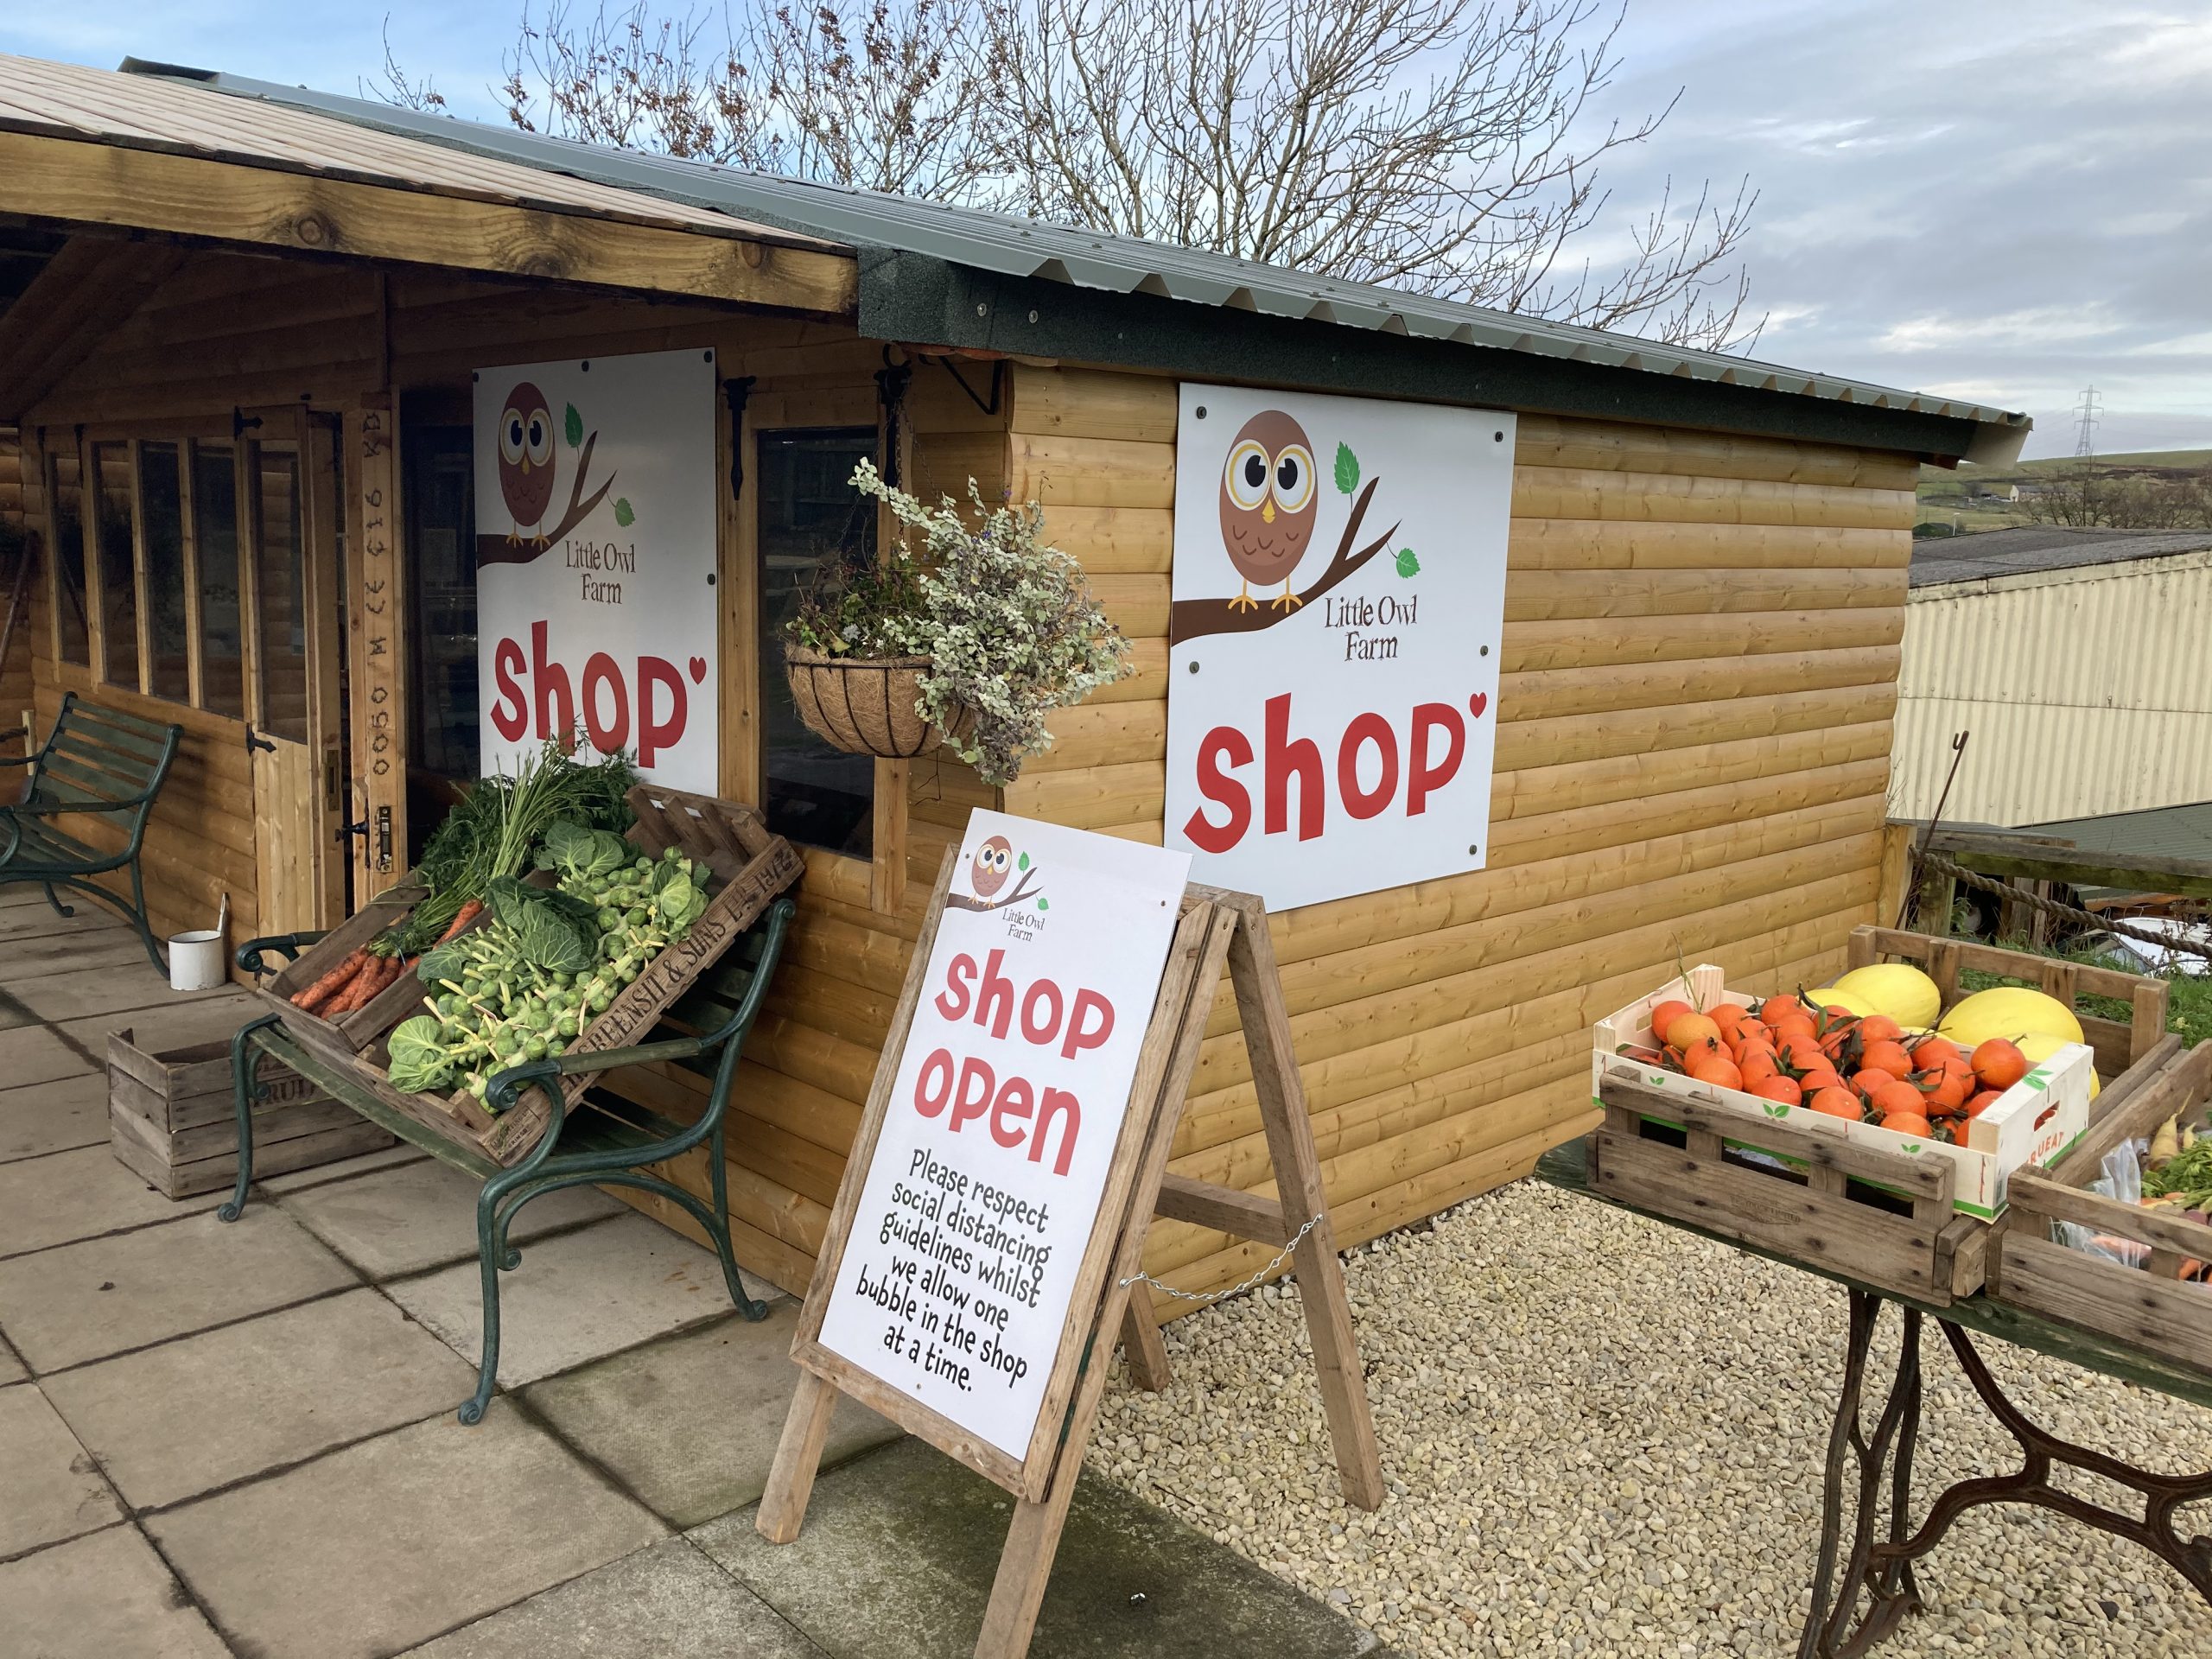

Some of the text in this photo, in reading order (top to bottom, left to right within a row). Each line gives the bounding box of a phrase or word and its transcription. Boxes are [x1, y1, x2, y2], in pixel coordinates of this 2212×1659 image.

[565, 540, 636, 574] Little Owl
[581, 574, 623, 605] Farm
[1325, 594, 1418, 629] Little Owl
[1344, 632, 1399, 662] Farm
[490, 620, 688, 769] shop
[1183, 691, 1466, 854] shop
[1002, 908, 1045, 931] Little Owl
[1007, 925, 1033, 942] Farm
[662, 959, 685, 983] &
[934, 948, 1116, 1060] shop
[913, 1047, 1082, 1177] open
[909, 1147, 1050, 1233] Please respect
[880, 1211, 1041, 1308] guidelines whilst
[892, 1182, 1052, 1283] social distancing
[855, 1263, 1027, 1388] bubble in the shop
[892, 1255, 1009, 1332] we allow one
[883, 1325, 972, 1392] at a time.
